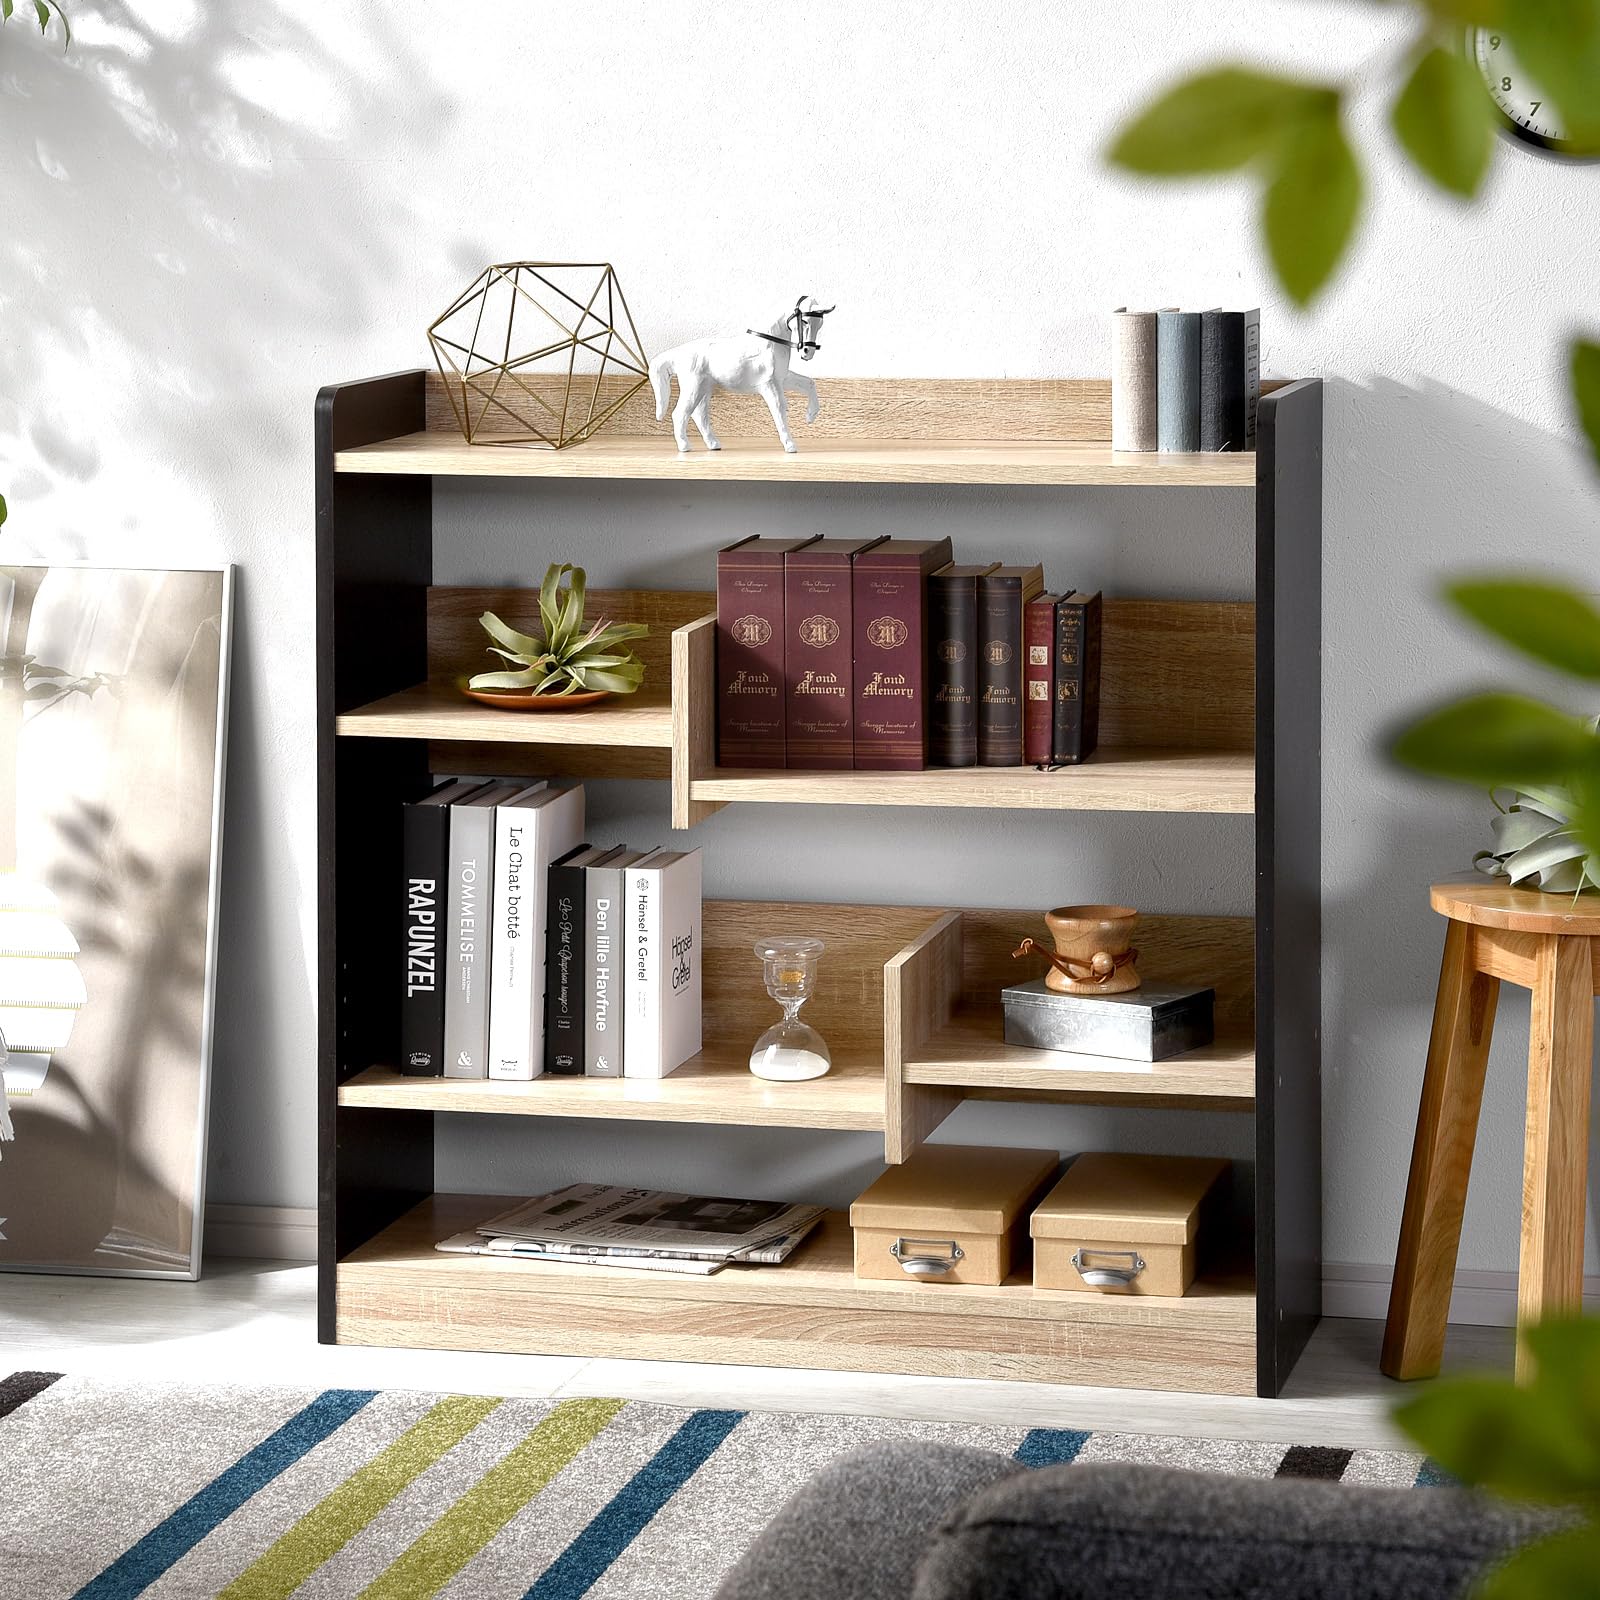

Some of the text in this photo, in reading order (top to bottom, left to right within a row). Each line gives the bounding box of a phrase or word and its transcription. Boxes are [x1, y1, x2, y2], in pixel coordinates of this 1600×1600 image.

[1489, 35, 1501, 51] 9
[1501, 76, 1512, 92] 8
[1530, 101, 1542, 117] 7
[736, 670, 769, 684] Fond
[803, 670, 837, 684] Fond
[871, 672, 905, 685] Fond
[727, 680, 778, 697] Memory
[795, 680, 846, 697] Memory
[862, 681, 914, 699] Memory
[935, 691, 971, 704] Memory
[982, 692, 1017, 705] Memory
[507, 826, 523, 940] Le Chat botté
[459, 858, 476, 963] TOMMELISE
[638, 894, 648, 932] Hänsel
[407, 878, 436, 998] RAPUNZEL
[638, 935, 648, 944] &
[671, 925, 693, 960] Hänsel
[595, 898, 611, 1032] Den lille Havfrue
[638, 948, 648, 982] Gretel
[671, 957, 691, 990] Gretel
[457, 1051, 473, 1066] &
[596, 1055, 609, 1069] &
[544, 1194, 641, 1232] International
